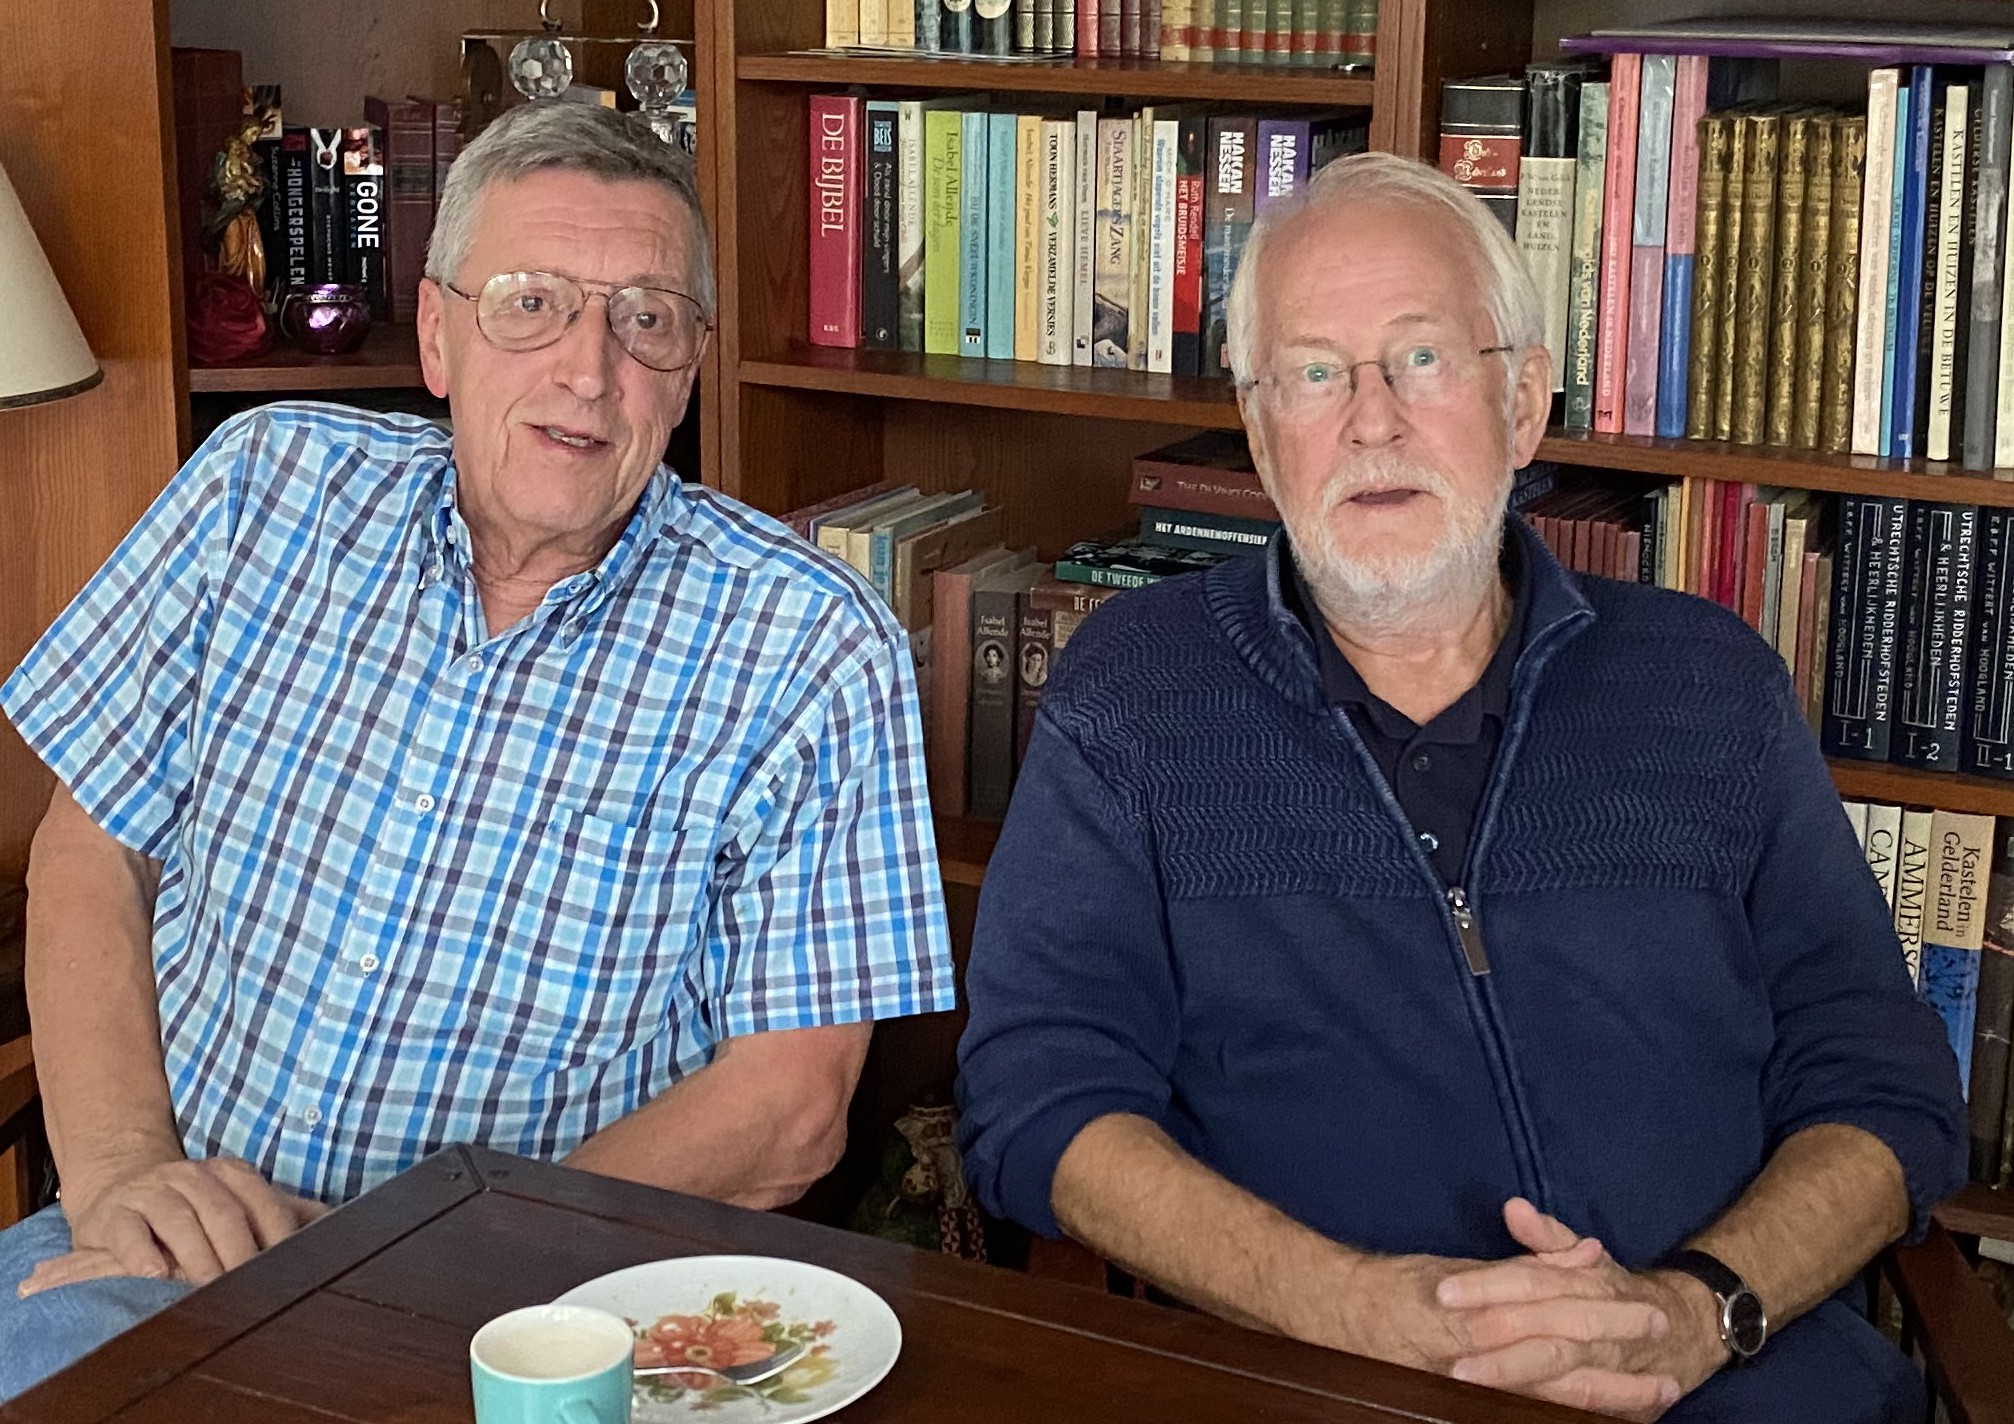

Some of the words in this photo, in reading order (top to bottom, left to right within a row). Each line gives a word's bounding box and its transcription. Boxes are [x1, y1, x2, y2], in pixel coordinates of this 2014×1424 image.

[822, 113, 844, 151] DE
[946, 132, 957, 170] Isabel
[1025, 128, 1034, 155] Isabel
[1049, 134, 1058, 161] TOON
[1931, 108, 1944, 174] KASTELEN
[271, 147, 280, 189] Suzanne
[933, 157, 944, 170] De
[1025, 157, 1033, 188] Allende
[1156, 139, 1165, 172] Waarom
[1218, 132, 1232, 193] NESSER
[1268, 135, 1283, 196] NESSER
[1950, 129, 1964, 208] KASTELEN
[816, 156, 844, 237] BIJBEL
[874, 172, 882, 196] Dood
[908, 179, 916, 225] ALLENDE
[933, 175, 942, 198] som
[945, 175, 957, 226] Allende
[1048, 163, 1058, 209] HERMANS
[1155, 176, 1164, 211] slapende
[1178, 180, 1188, 200] HET
[1191, 180, 1200, 202] Ruth
[1930, 181, 1940, 197] EN
[272, 193, 281, 231] Collins
[287, 169, 304, 285] HONGERSPELEN
[357, 182, 379, 248] GONE
[932, 201, 944, 218] der
[1080, 210, 1089, 242] LIEVE
[1153, 214, 1162, 240] vogels
[1189, 205, 1199, 239] Rendell
[1224, 208, 1235, 221] De
[1521, 209, 1567, 217] KASTELEN
[1948, 215, 1959, 234] EN
[882, 223, 890, 241] mijn
[930, 220, 943, 252] dagen
[1110, 226, 1124, 265] ZANG
[1176, 203, 1188, 275] BRUIDSMEISJE
[1224, 225, 1232, 246] man
[1523, 242, 1559, 251] HUIZEN
[1928, 204, 1939, 255] HUIZEN
[1047, 232, 1057, 294] VERZAMELDE
[1079, 246, 1088, 286] HEMEL
[1926, 260, 1935, 277] OP
[1944, 241, 1959, 299] HUIZEN
[1581, 281, 1592, 305] van
[1605, 260, 1616, 313] KASTELEN
[1924, 282, 1934, 299] DE
[1046, 296, 1056, 336] VERSJES
[1943, 306, 1955, 322] IN
[1576, 309, 1593, 385] Nederland
[1942, 329, 1953, 348] DE
[1601, 330, 1613, 397] NEDERLAND
[1938, 353, 1951, 416] BETUWE
[1155, 522, 1171, 534] HET
[1174, 524, 1268, 546] ARDENNENOFFENSIEF
[1642, 524, 1651, 582] NIENOORD
[1771, 528, 1779, 562] BERGH
[1871, 536, 1884, 547] &
[1885, 505, 1904, 596] UTRECHTSCHE
[1940, 542, 1952, 553] &
[1841, 542, 1853, 593] WITTERT
[1911, 547, 1922, 597] WITTERT
[1955, 511, 1974, 602] UTRECHTSCHE
[1091, 570, 1104, 583] DE
[1107, 572, 1144, 587] TWEEDE
[1984, 561, 1996, 616] WITTERT
[981, 615, 1005, 626] Isabel
[1024, 616, 1047, 627] Isabel
[1074, 597, 1085, 611] DE
[1862, 551, 1882, 659] HEERLIJKHEDEN
[1930, 556, 1949, 667] HEERLIJKHEDEN
[976, 626, 1008, 637] Allende
[1020, 627, 1051, 639] Allende
[1834, 619, 1848, 679] HOOGLAND
[1876, 600, 1896, 722] RIDDERHOFSTEDEN
[1904, 629, 1918, 689] HOOGLAND
[1944, 609, 1966, 731] RIDDERHOFSTEDEN
[1975, 648, 1991, 713] HOOGLAND
[1937, 831, 1961, 931] Gelderland
[1957, 847, 1981, 922] Kastelen
[1900, 838, 1927, 977] AMMERS
[1955, 926, 1965, 938] in
